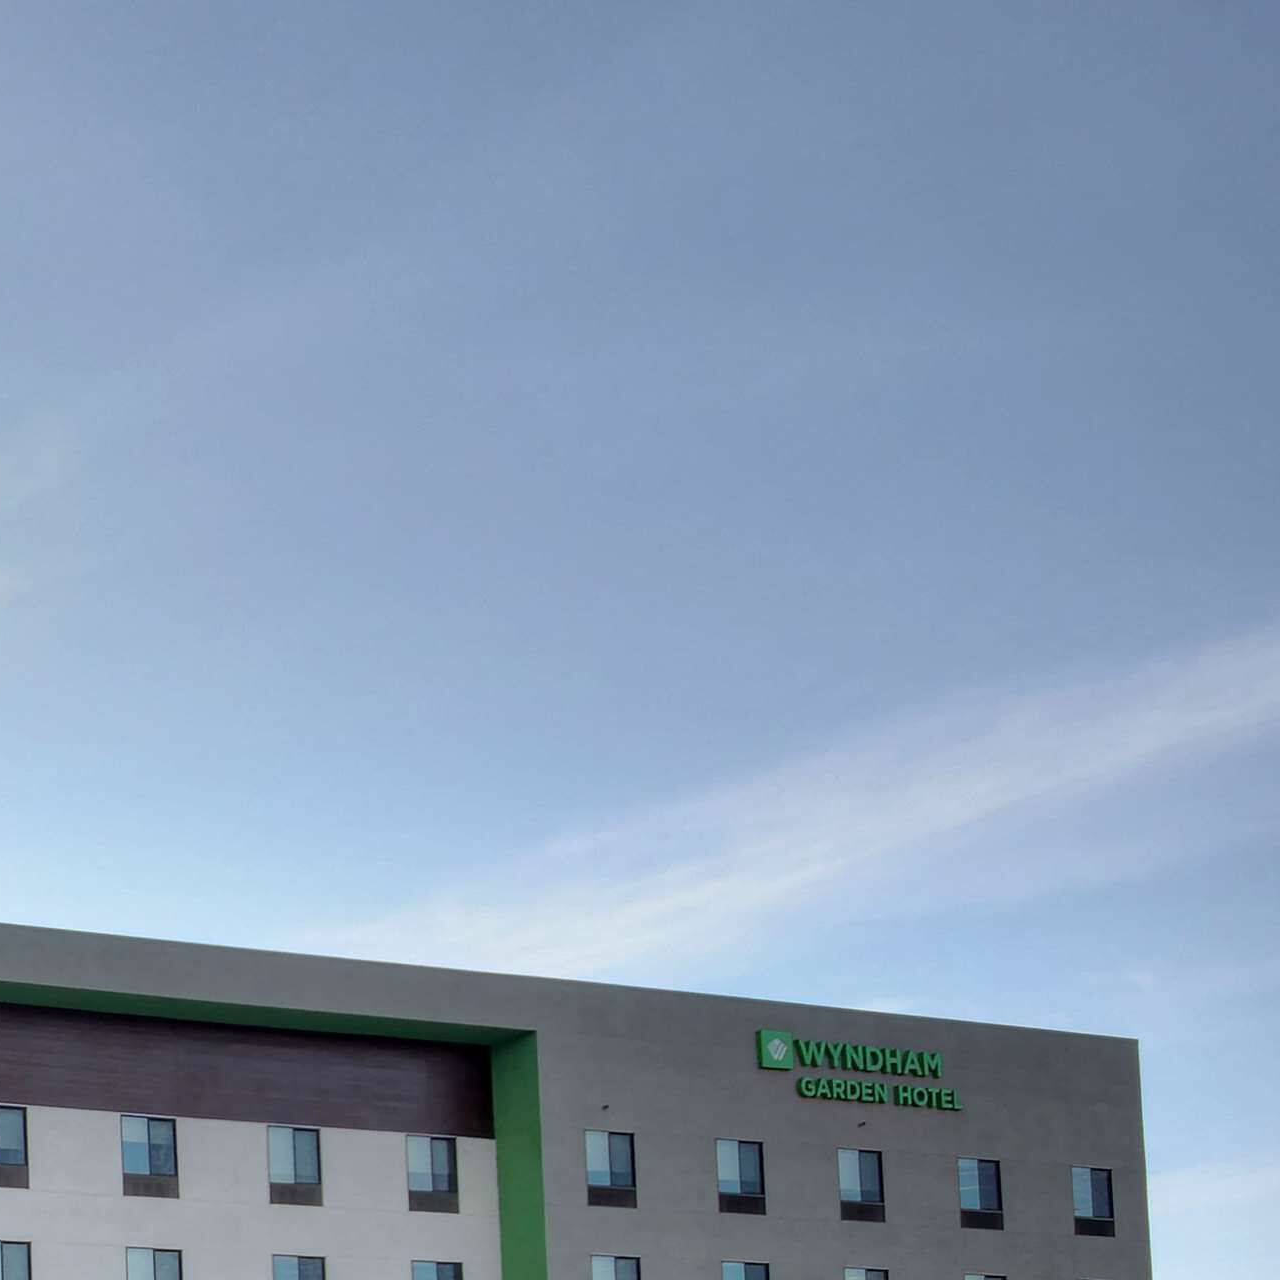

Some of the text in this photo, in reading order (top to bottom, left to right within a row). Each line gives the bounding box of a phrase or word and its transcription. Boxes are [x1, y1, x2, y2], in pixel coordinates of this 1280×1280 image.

[794, 1039, 942, 1078] WYNDHAM
[798, 1076, 964, 1110] GARDEN HOTEL
